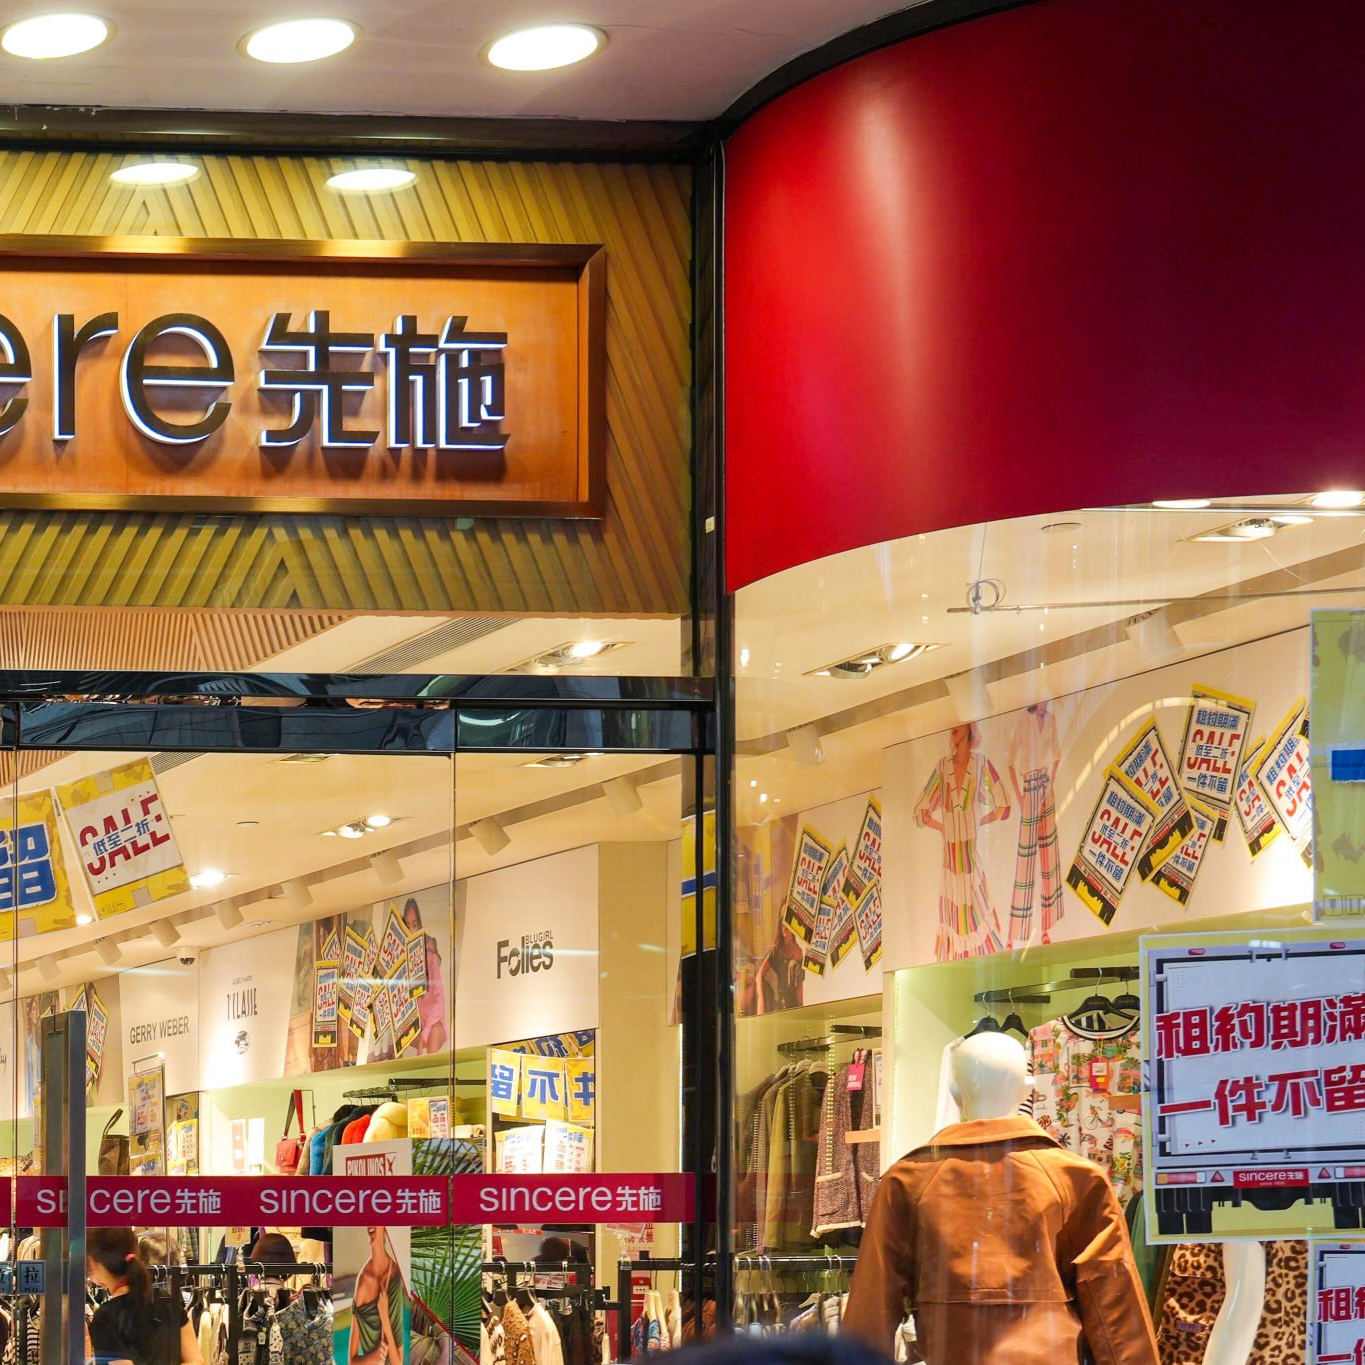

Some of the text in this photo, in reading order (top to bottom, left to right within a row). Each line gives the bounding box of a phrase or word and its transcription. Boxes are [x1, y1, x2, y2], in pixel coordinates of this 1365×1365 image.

[257, 308, 510, 451] 先施
[1186, 728, 1241, 775] SALE
[78, 793, 171, 877] SALE
[92, 819, 151, 858] 低至二折
[1090, 808, 1143, 867] SALE
[496, 936, 554, 980] Folies
[129, 1014, 190, 1045] GERRY WEBER
[175, 1187, 222, 1215] 先施
[259, 1186, 442, 1214] sincere 先施
[479, 1185, 662, 1213] sincere 先施
[24, 1266, 40, 1284] 拉
